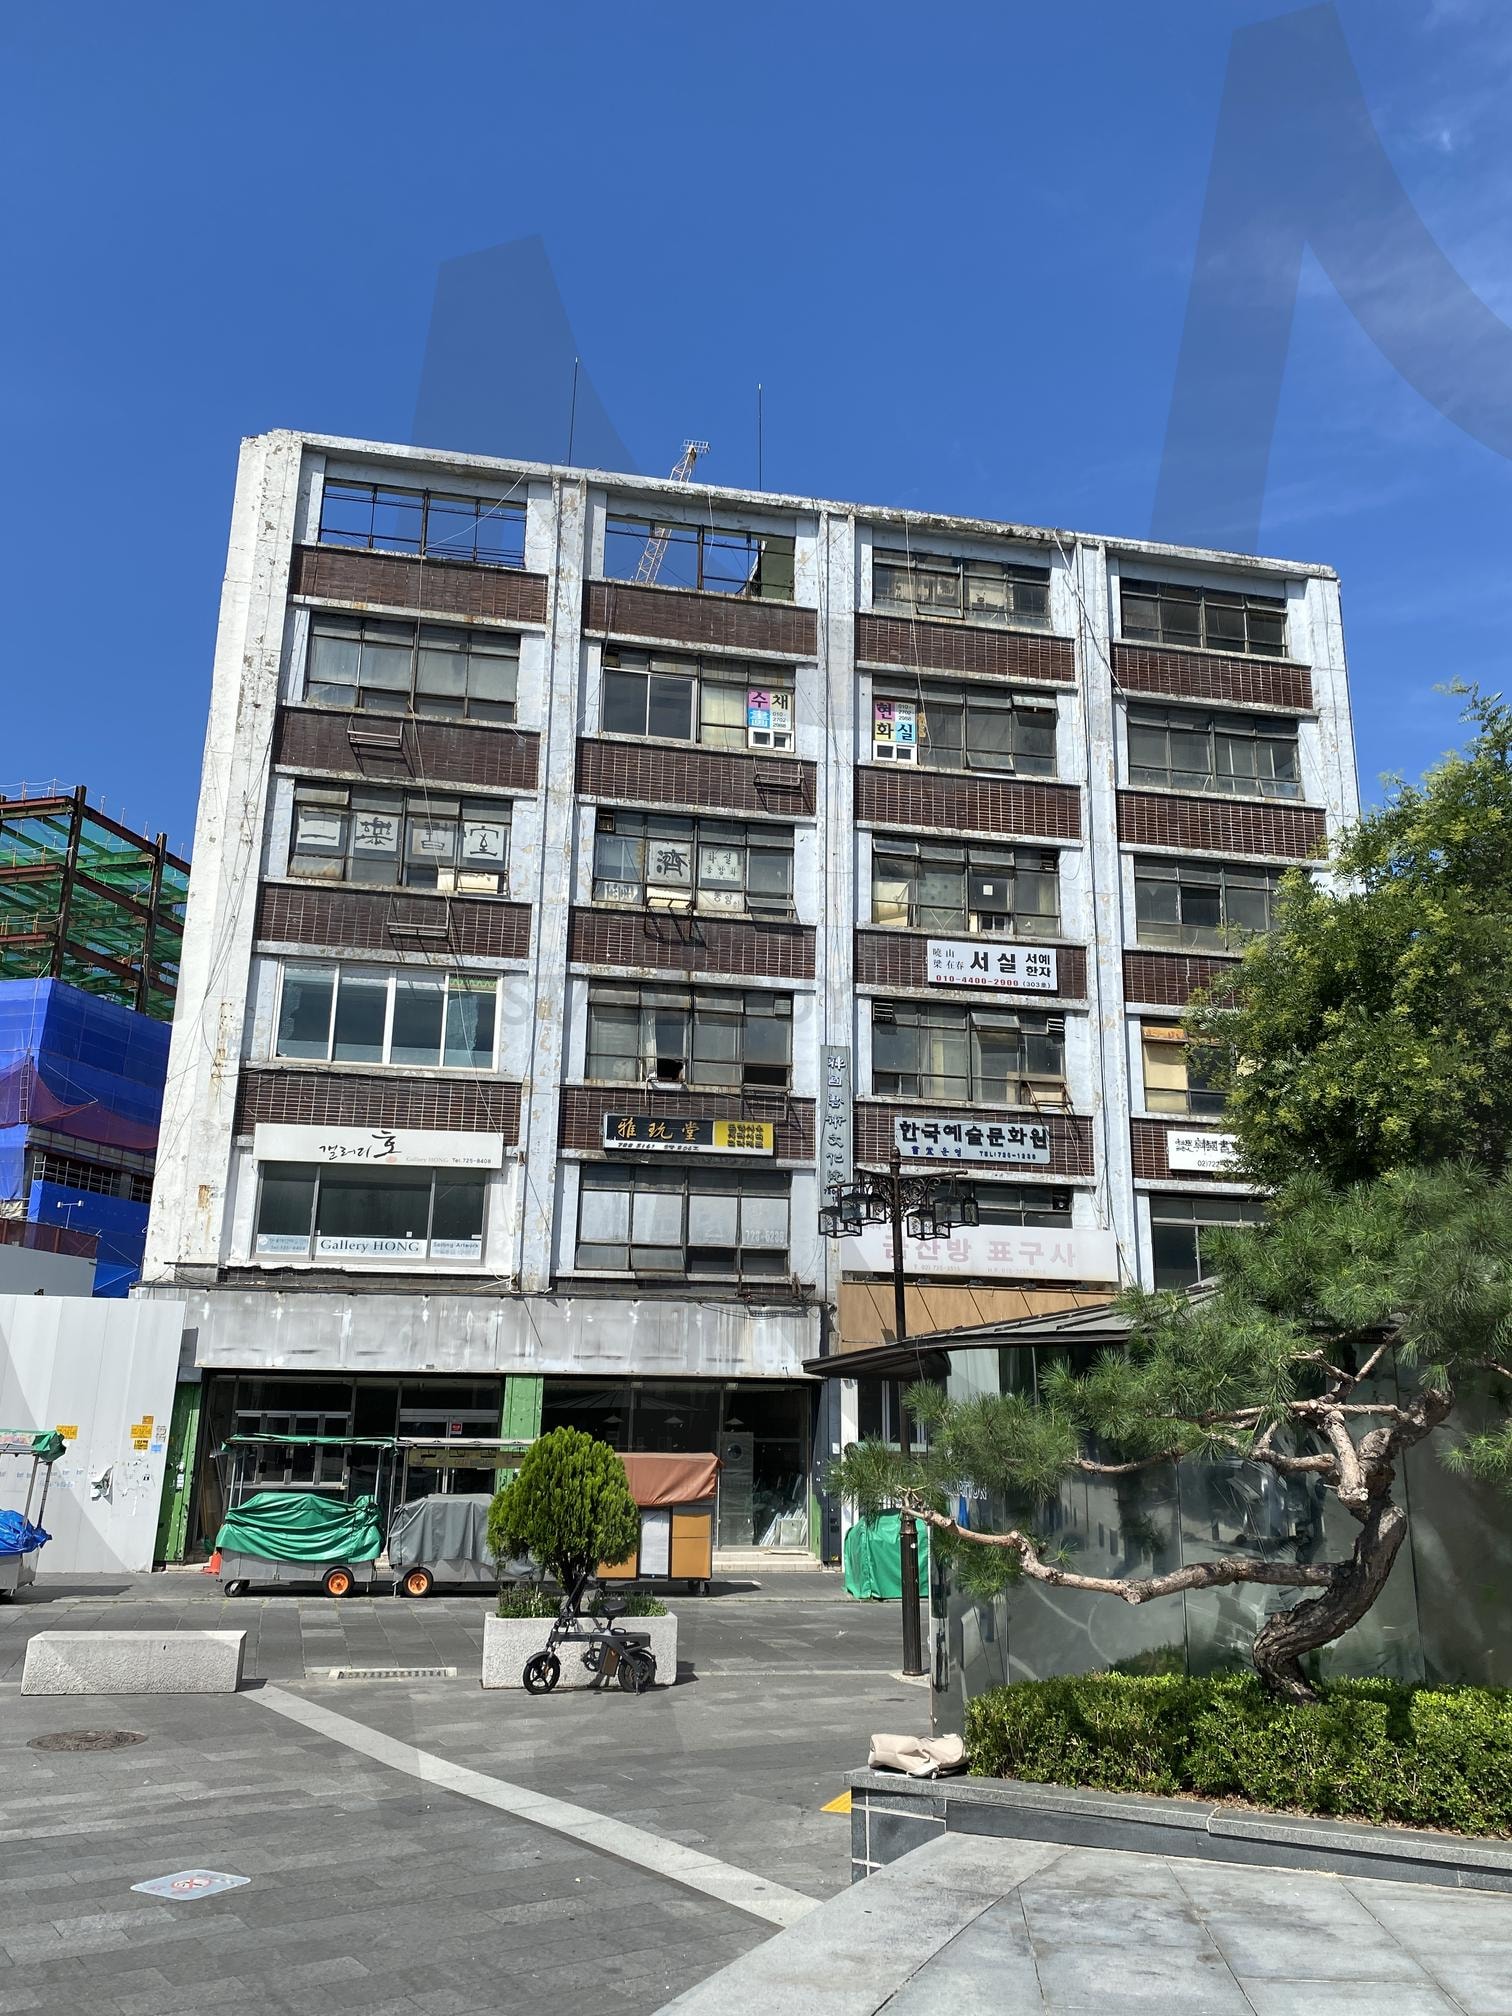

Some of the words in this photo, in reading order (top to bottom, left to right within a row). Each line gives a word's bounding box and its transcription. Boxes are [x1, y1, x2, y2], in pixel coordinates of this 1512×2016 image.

[751, 692, 788, 710] 수채
[877, 702, 892, 719] 현
[970, 951, 1016, 974] 서실
[1025, 953, 1050, 965] 서예
[1025, 966, 1051, 977] 한자
[899, 1120, 1048, 1150] 한국예술문화원
[319, 1143, 370, 1161] 갤러리
[320, 1239, 368, 1254] Gallery
[372, 1241, 420, 1252] HONG
[986, 1240, 1077, 1268] 표구사
